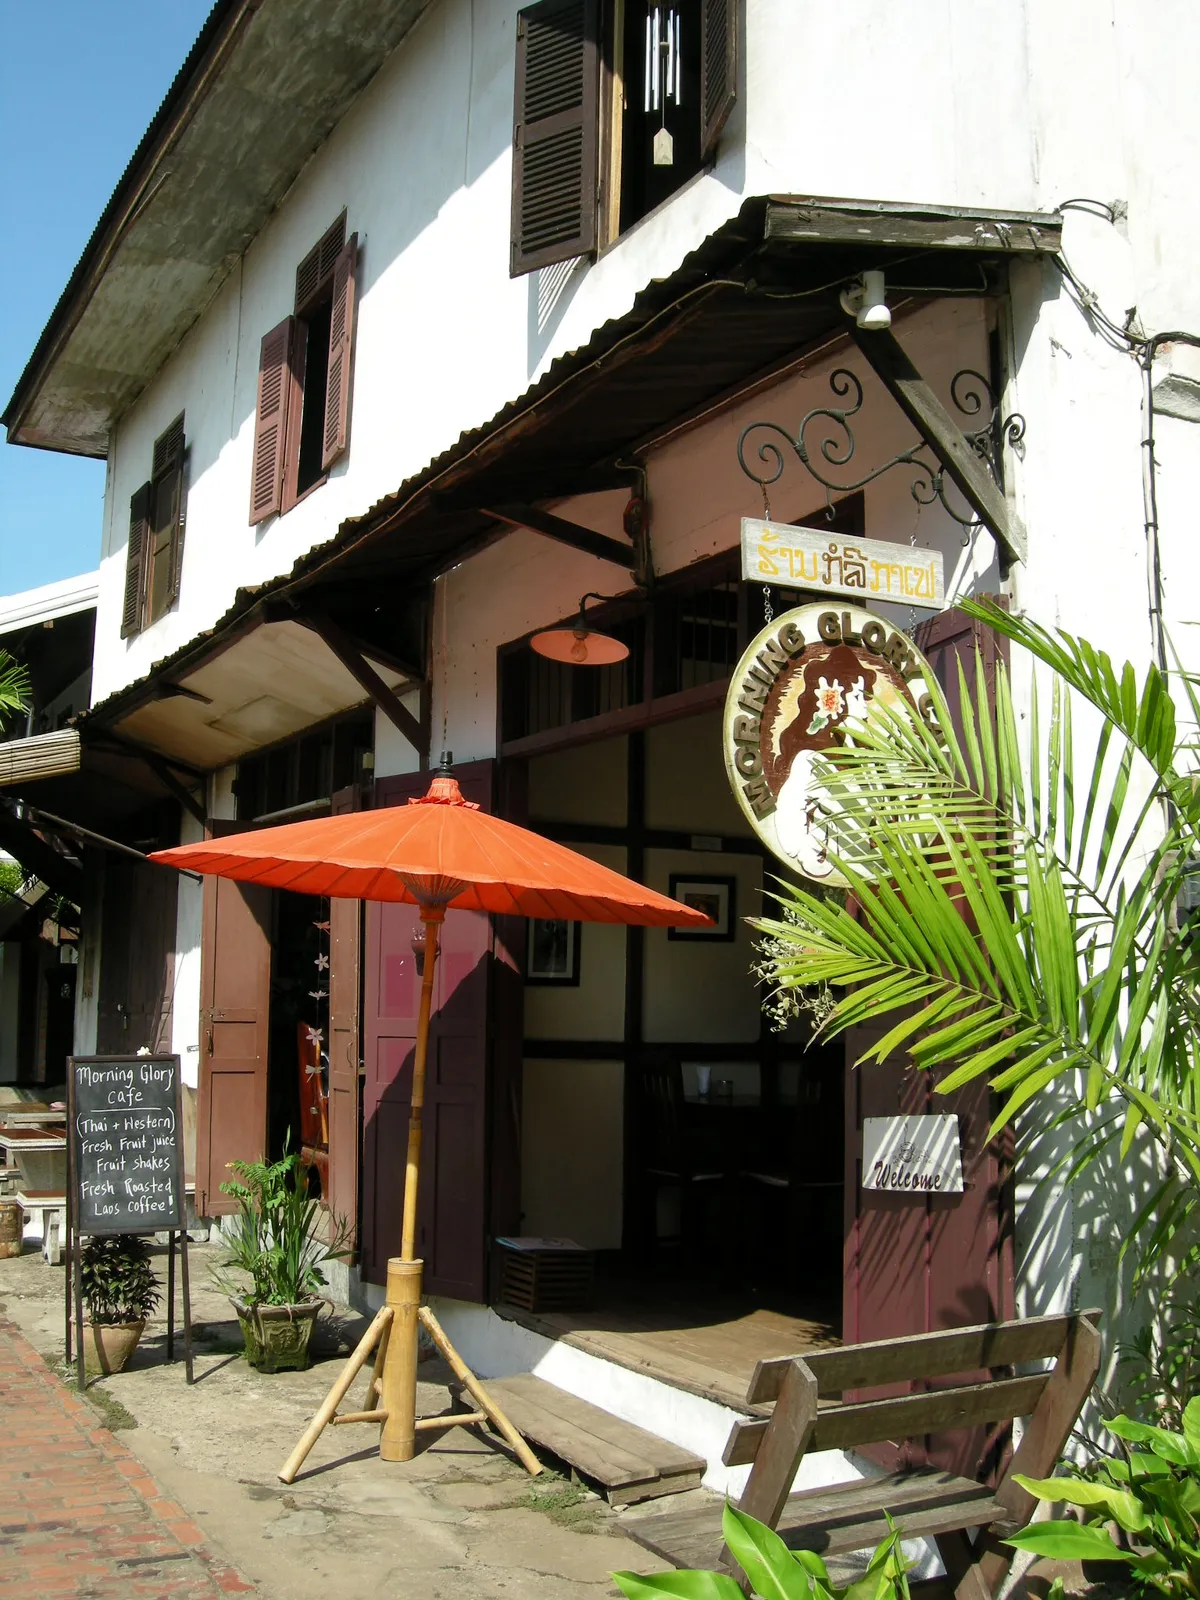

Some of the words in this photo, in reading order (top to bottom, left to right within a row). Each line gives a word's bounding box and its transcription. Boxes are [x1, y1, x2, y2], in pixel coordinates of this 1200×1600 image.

[734, 622, 805, 822] MORNING
[817, 611, 922, 683] GLORY
[76, 1065, 134, 1089] Morning
[140, 1064, 175, 1092] Glory
[76, 1112, 108, 1138] (Thai
[124, 1106, 176, 1134] Western)
[81, 1139, 113, 1155] Fresh
[119, 1134, 147, 1151] Fruit
[150, 1135, 176, 1153] juice
[96, 1155, 127, 1175] Fruit
[132, 1154, 171, 1172] shakes
[873, 1160, 941, 1190] Welcome
[81, 1180, 115, 1200] Fresh
[124, 1177, 172, 1197] Roasted
[94, 1202, 120, 1216] Laos
